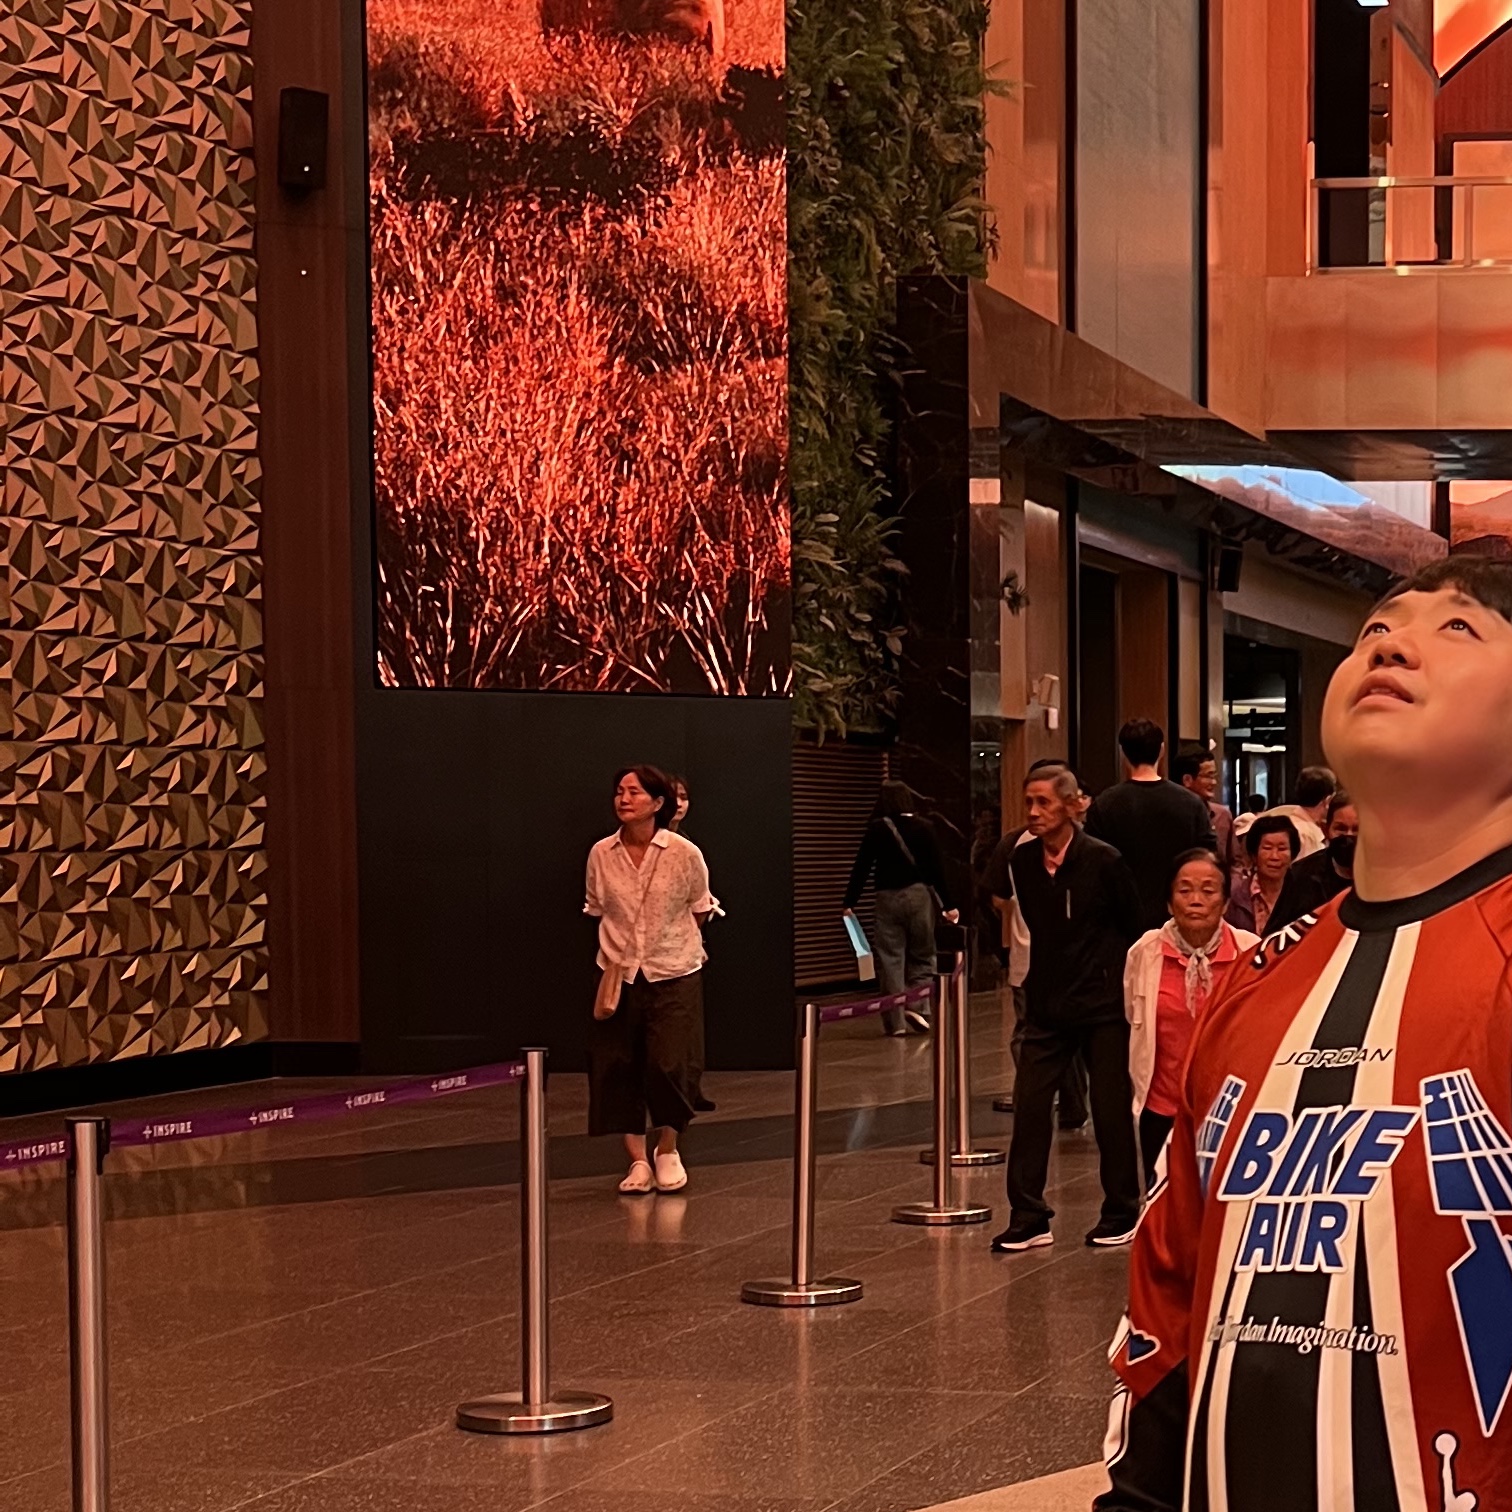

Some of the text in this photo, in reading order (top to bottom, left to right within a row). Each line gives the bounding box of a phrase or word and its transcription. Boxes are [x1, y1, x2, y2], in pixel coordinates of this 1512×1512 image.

[1275, 1047, 1394, 1067] JORDAN
[353, 1091, 386, 1107] INSPIRE
[258, 1106, 294, 1123] INSPIRE
[153, 1121, 192, 1137] INSPIRE
[18, 1140, 66, 1160] INSPIRE
[1217, 1106, 1421, 1201] BIKE
[1234, 1199, 1349, 1272] AIR
